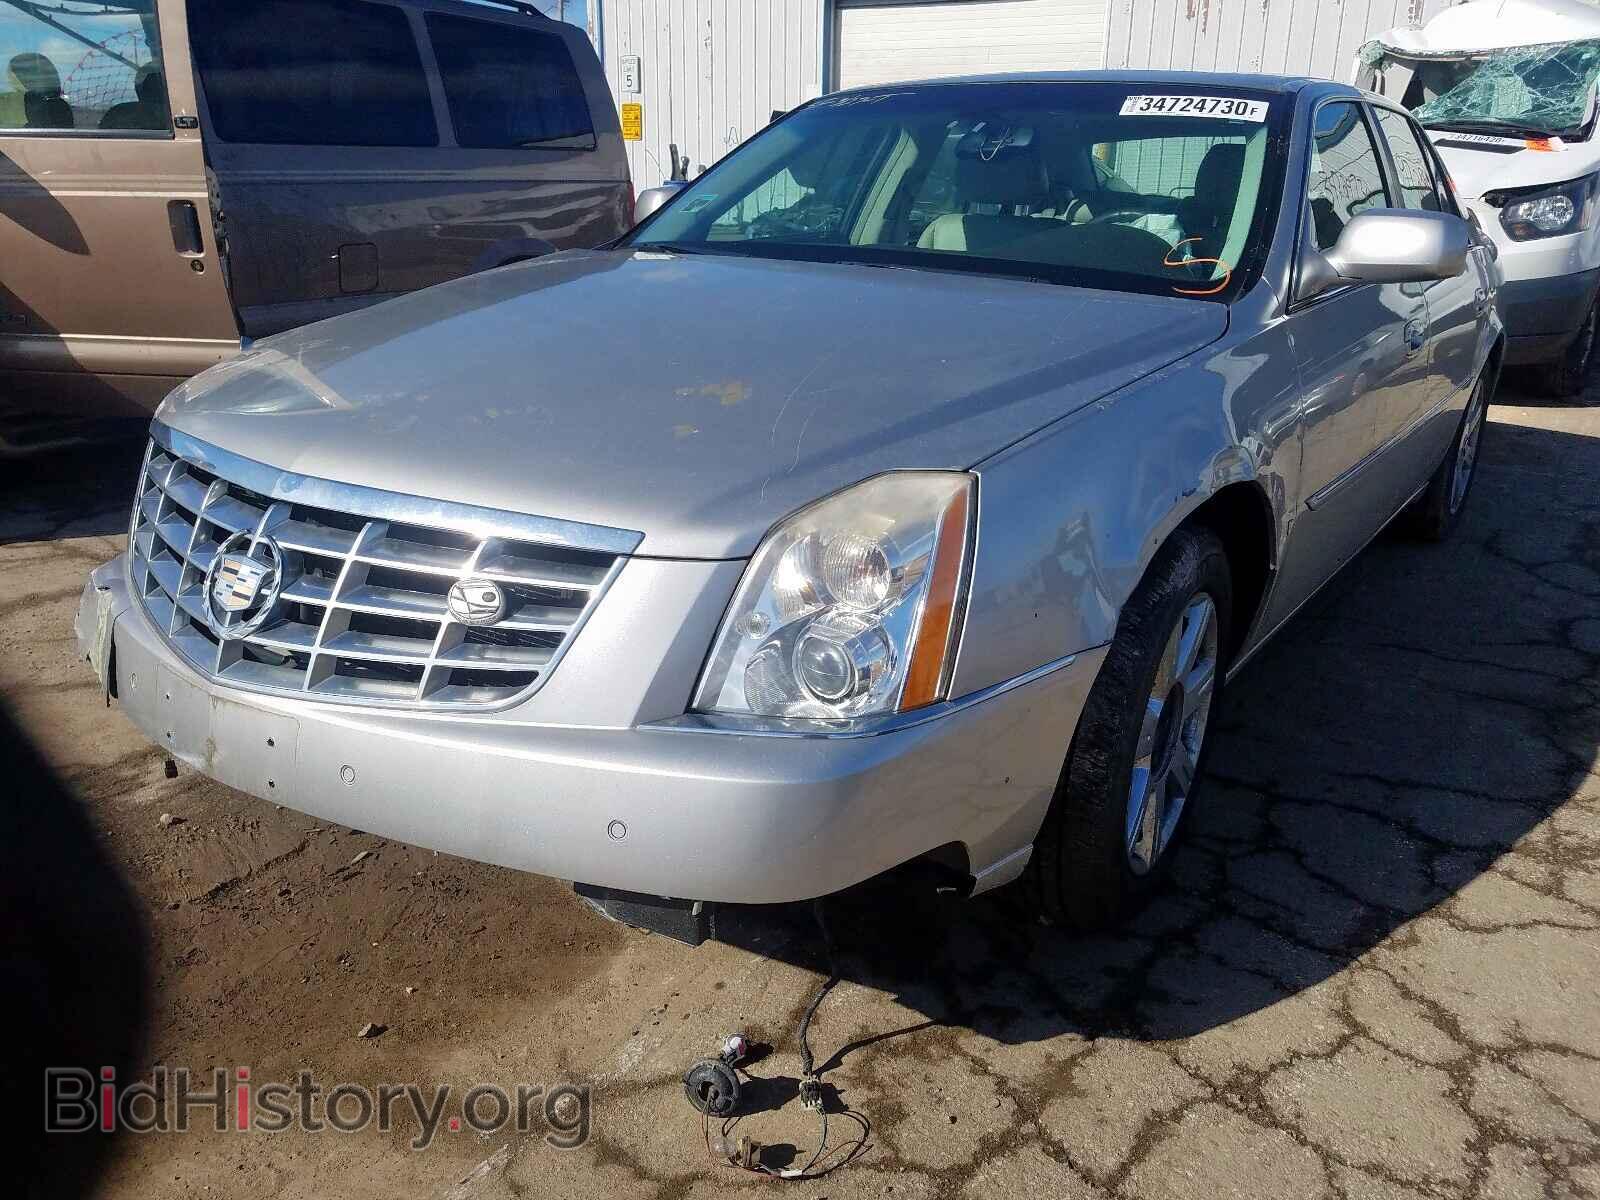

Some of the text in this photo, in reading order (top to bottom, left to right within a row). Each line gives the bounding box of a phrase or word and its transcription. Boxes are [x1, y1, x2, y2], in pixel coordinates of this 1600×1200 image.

[626, 74, 633, 87] 5
[1139, 97, 1249, 116] 34724730
[1250, 107, 1259, 116] F
